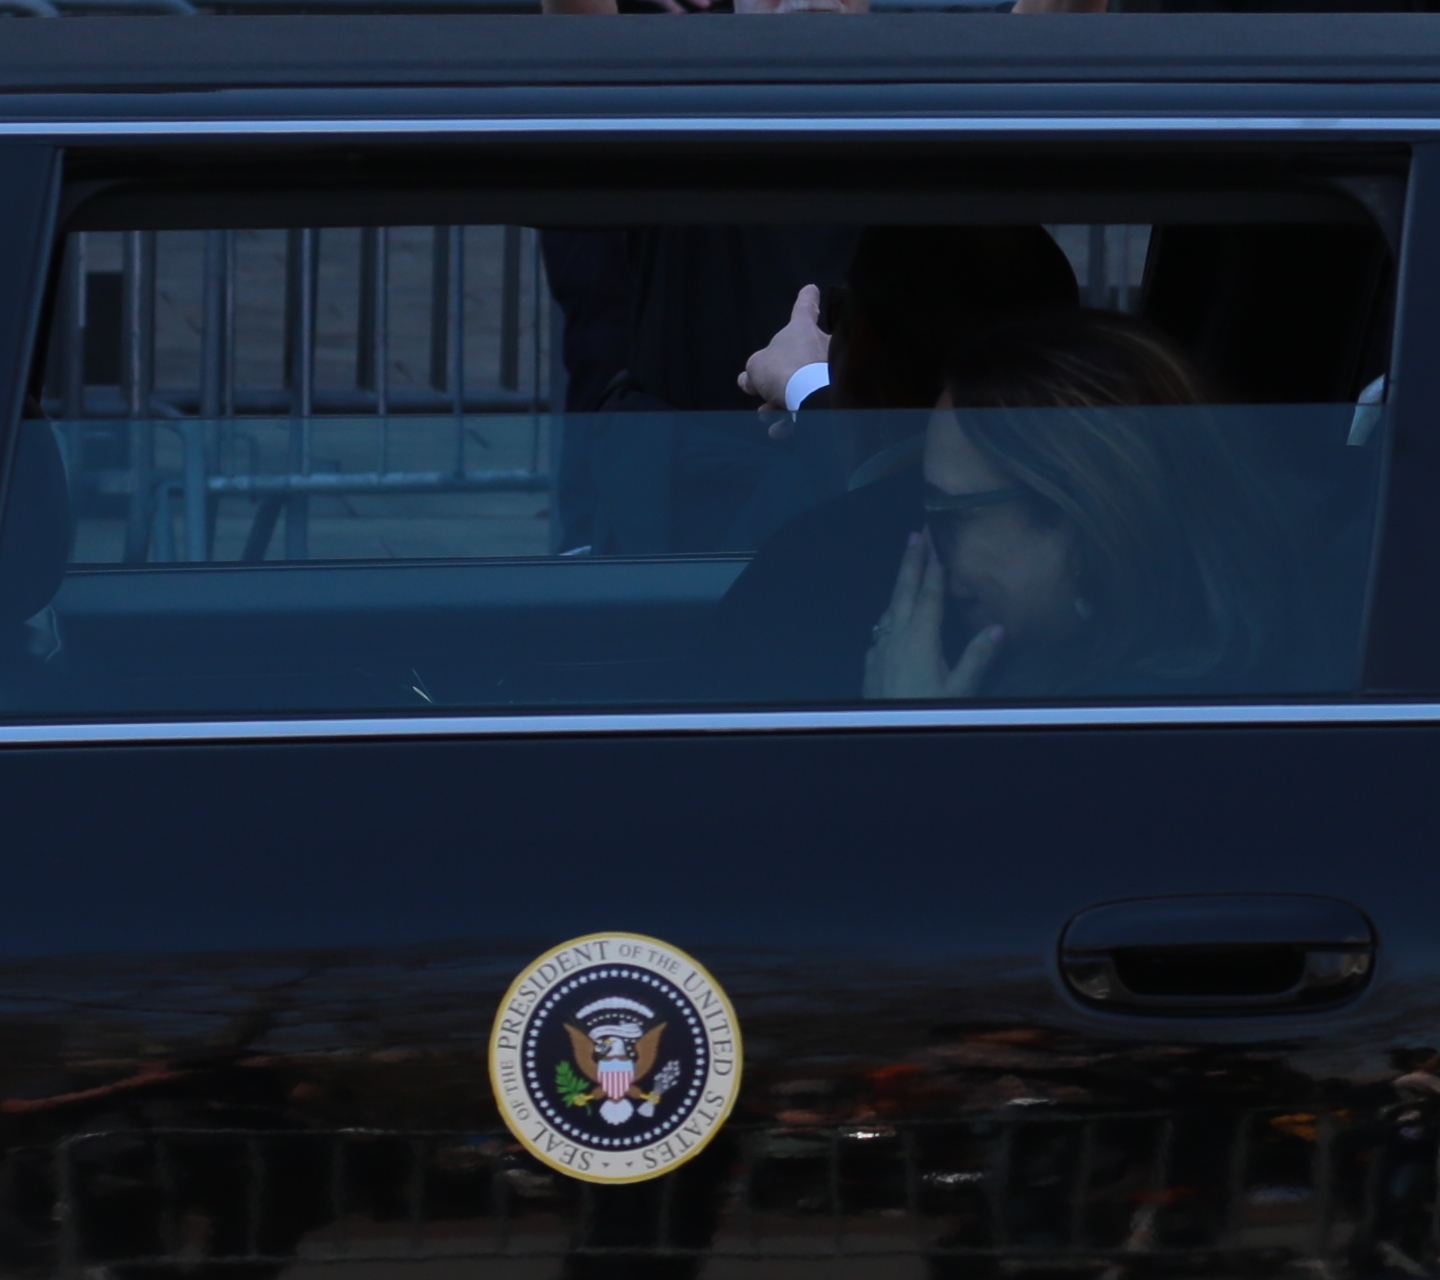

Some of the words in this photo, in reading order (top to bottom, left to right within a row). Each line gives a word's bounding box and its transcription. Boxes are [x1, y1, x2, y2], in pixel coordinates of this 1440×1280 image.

[618, 944, 643, 958] OF
[647, 949, 681, 976] THE
[497, 940, 611, 1052] PRESIDENT
[681, 970, 734, 1078] UNITED
[500, 1059, 520, 1096] THE
[511, 1098, 531, 1122] OF
[640, 1089, 726, 1170] STATES
[533, 1119, 595, 1172] SEAL
